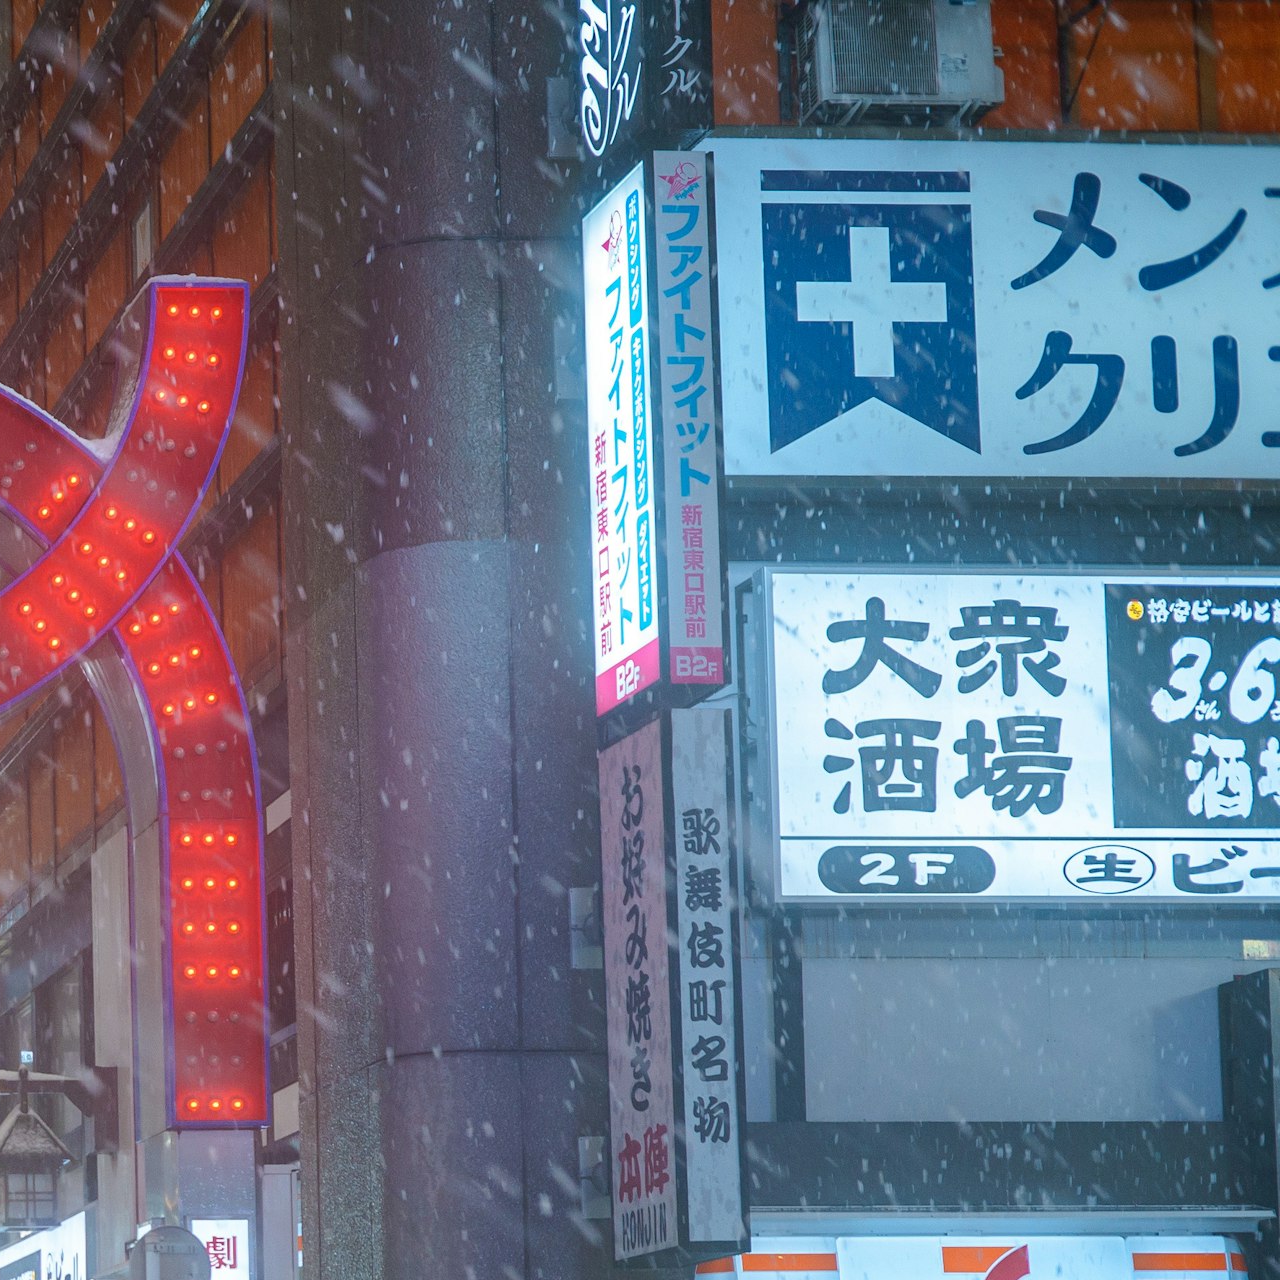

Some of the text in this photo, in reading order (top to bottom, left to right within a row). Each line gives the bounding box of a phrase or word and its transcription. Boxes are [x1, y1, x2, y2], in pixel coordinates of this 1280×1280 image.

[628, 195, 639, 311] ボクシング
[1011, 172, 1280, 292] メン
[662, 204, 711, 497] ファイトフィット
[1016, 331, 1280, 458] クリ
[605, 275, 633, 646] ファイトフィット
[594, 430, 613, 658] 新宿東口駅前
[638, 520, 650, 623] ダイエット
[681, 504, 706, 639] 新宿東口駅前
[821, 596, 1072, 699] 大衆
[1147, 598, 1280, 624] 格安ビールと
[616, 659, 640, 701] B2F
[676, 655, 718, 677] B2F
[822, 716, 1073, 818] 酒場
[858, 852, 955, 887] 2F
[621, 765, 652, 1113] お好み焼き
[682, 807, 732, 1144] 歌舞伎町名物
[618, 1124, 669, 1203] 本陣
[621, 1205, 667, 1246] HONJIN
